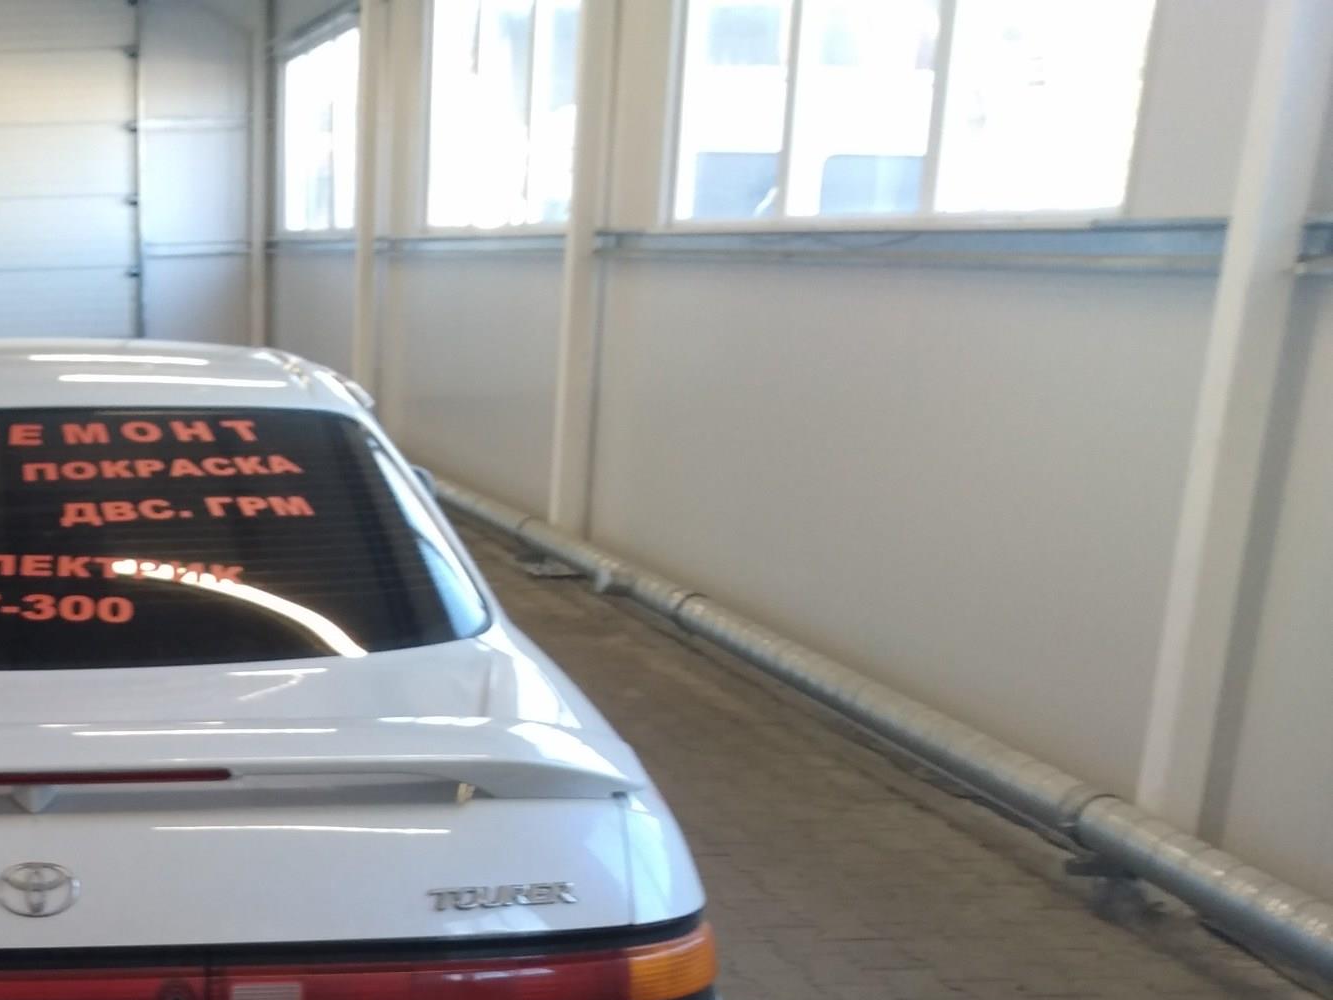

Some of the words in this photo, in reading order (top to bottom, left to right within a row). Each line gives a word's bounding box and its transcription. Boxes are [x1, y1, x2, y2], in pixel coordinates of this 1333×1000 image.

[21, 454, 303, 483] ПОКРАСКА
[58, 497, 193, 528] ДВС.
[204, 494, 315, 518] ГРМ
